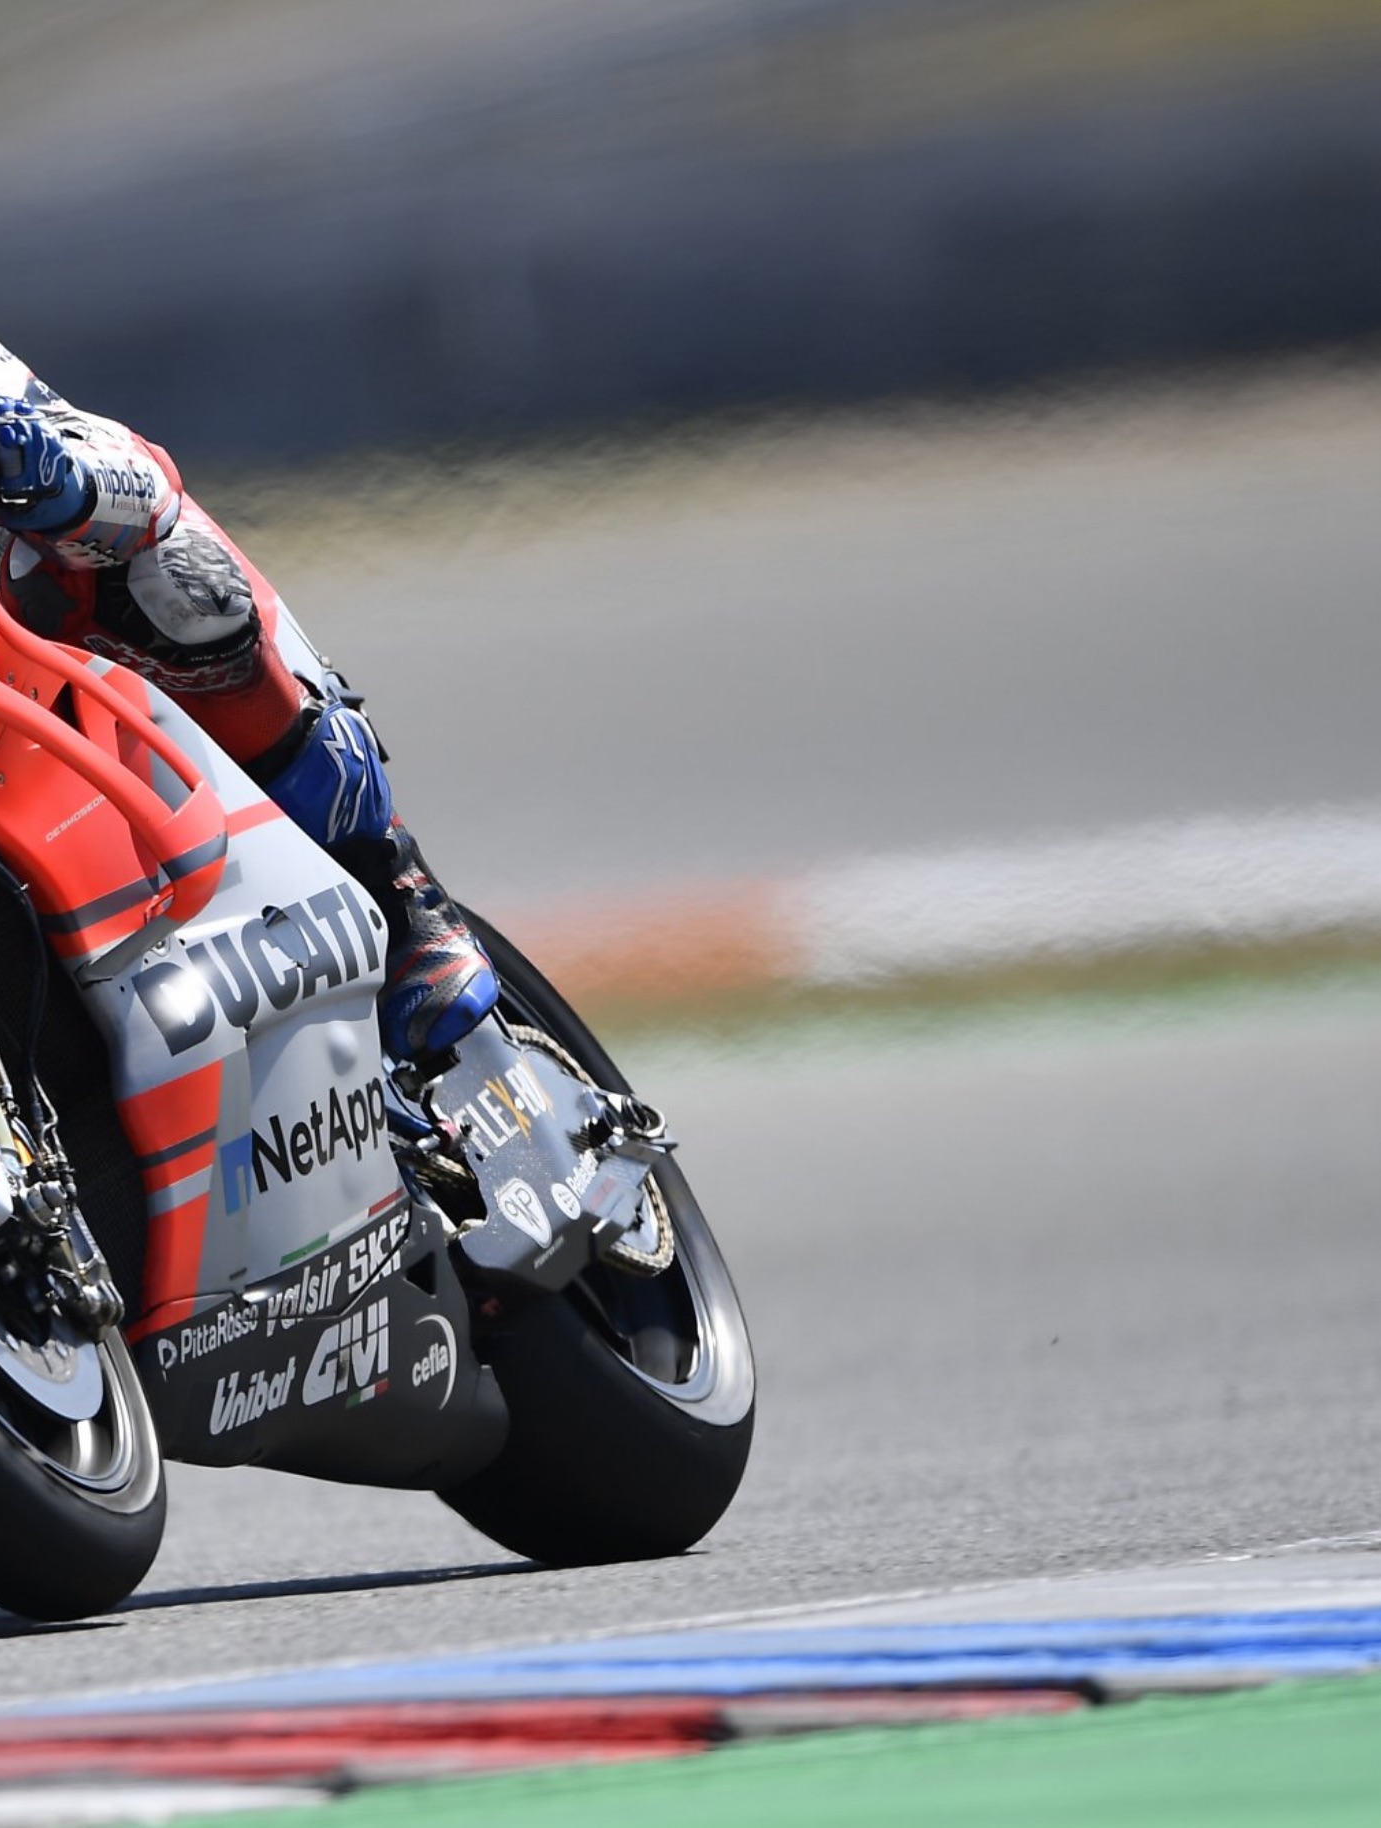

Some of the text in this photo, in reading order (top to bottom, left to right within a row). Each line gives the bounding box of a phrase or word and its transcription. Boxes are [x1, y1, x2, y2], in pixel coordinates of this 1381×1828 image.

[132, 882, 380, 1057] DUCATI
[252, 1077, 386, 1194] NetApp
[348, 1210, 410, 1294] SKF
[181, 1304, 259, 1364] PittaRosso
[267, 1256, 342, 1338] valsir
[303, 1297, 389, 1406] GIVI
[412, 1342, 450, 1387] cefla
[210, 1357, 296, 1437] Unibat
